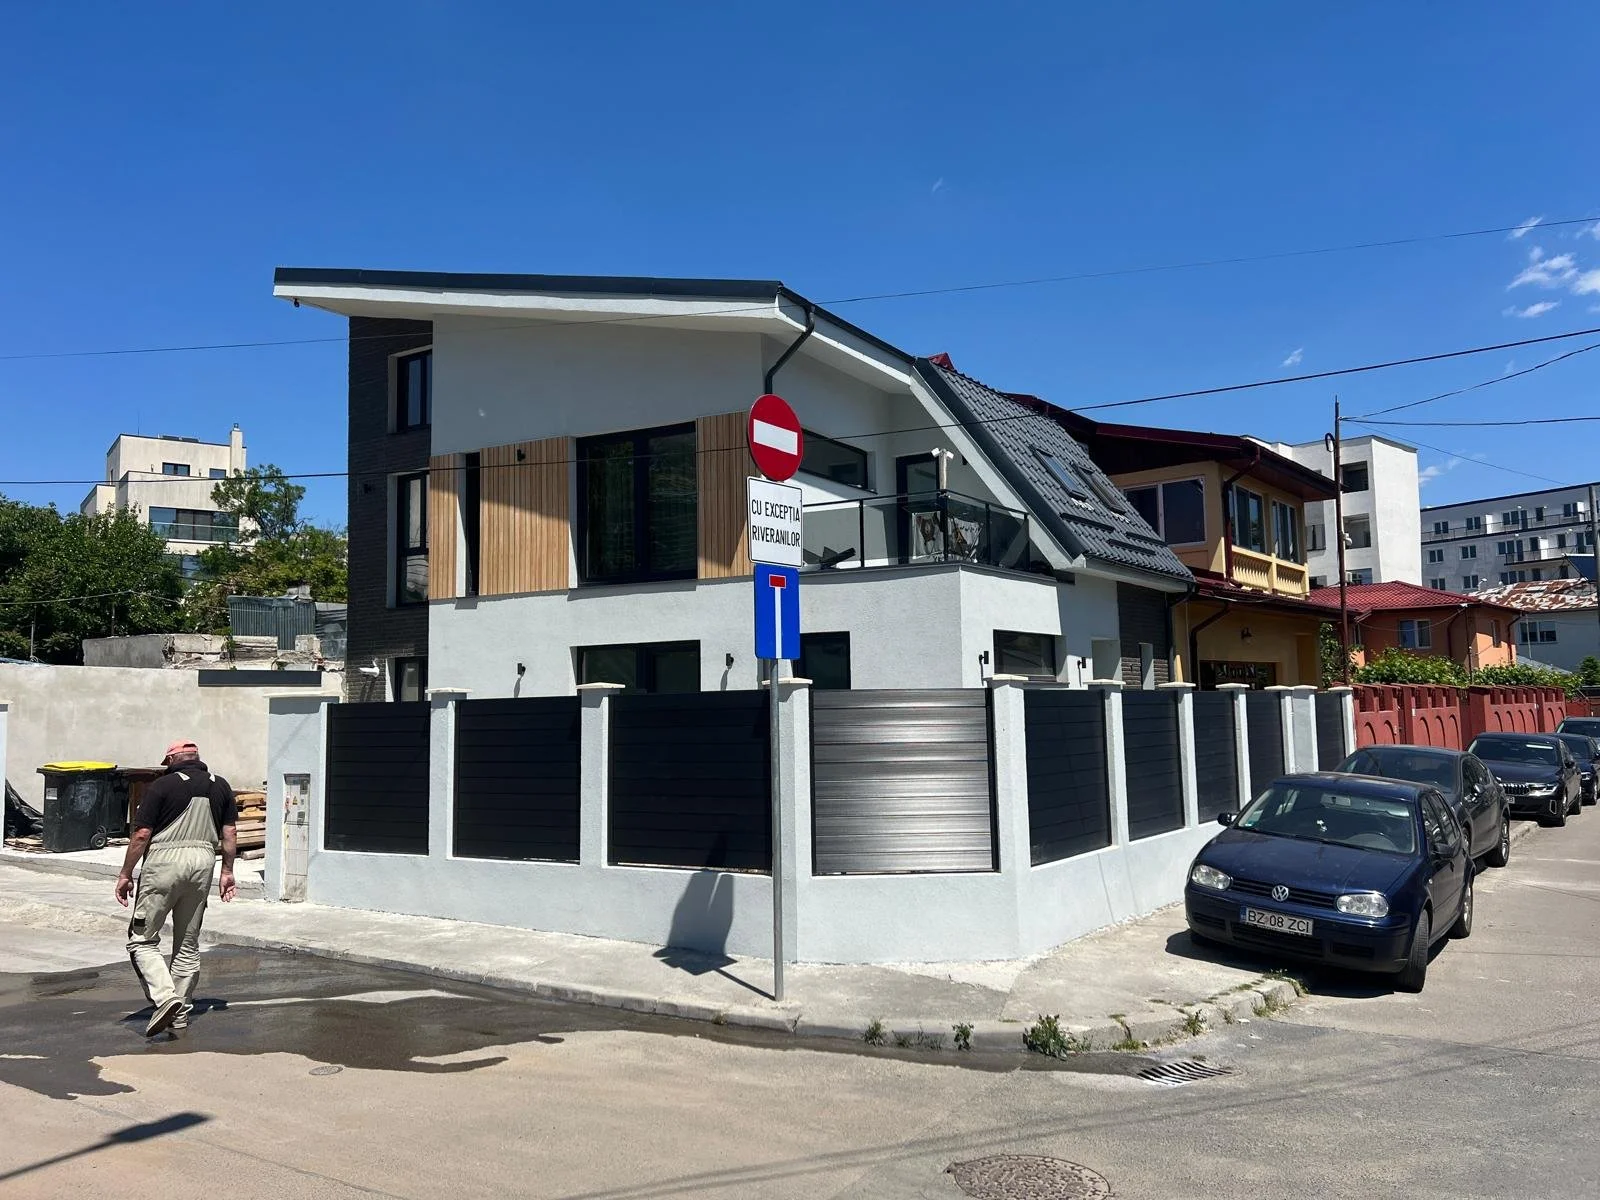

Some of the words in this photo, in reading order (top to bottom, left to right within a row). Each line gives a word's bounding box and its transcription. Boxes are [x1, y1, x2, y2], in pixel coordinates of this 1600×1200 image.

[751, 499, 762, 515] CU
[764, 502, 800, 523] EXCEPȚIA
[752, 525, 800, 547] RIVERANILOR
[1248, 910, 1265, 925] BZ
[1269, 914, 1284, 928] 08
[1287, 918, 1309, 933] ZCI
